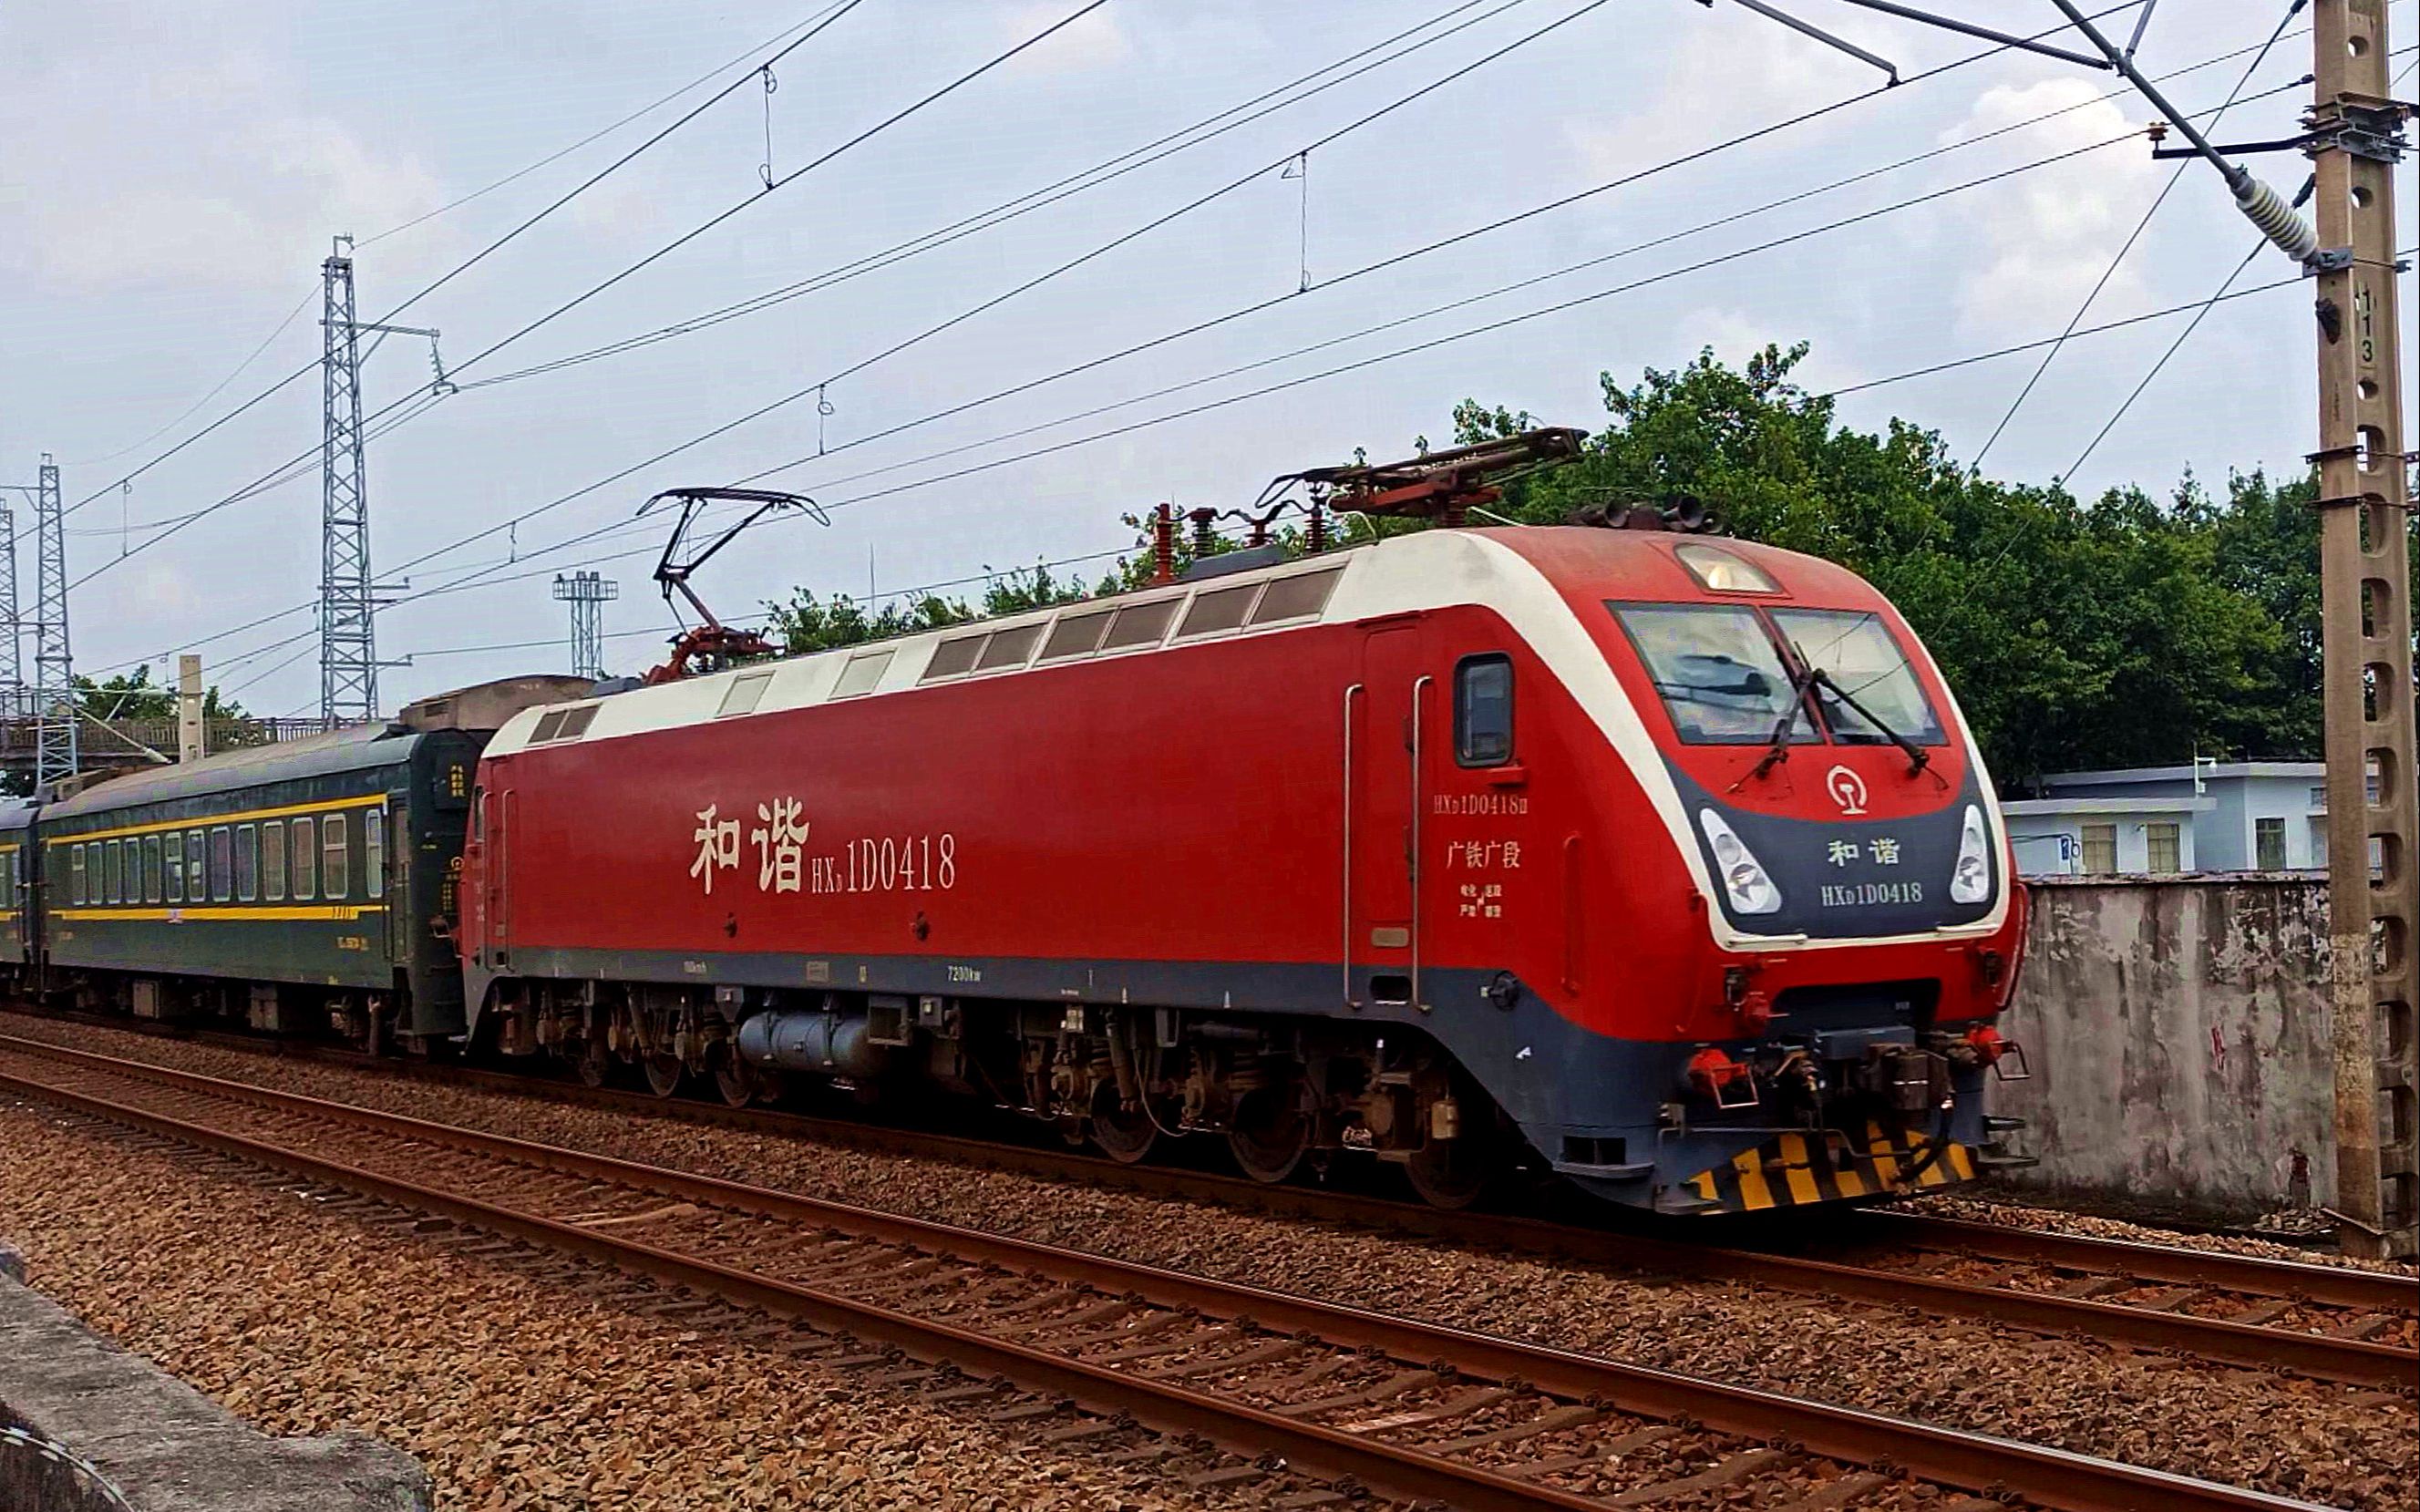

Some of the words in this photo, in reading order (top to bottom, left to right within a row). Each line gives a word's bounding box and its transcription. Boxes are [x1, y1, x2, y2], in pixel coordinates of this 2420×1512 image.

[690, 796, 810, 895] 和谐
[1446, 840, 1521, 869] 广铁广段
[1828, 838, 1900, 867] 和谐
[1821, 881, 1923, 907] HXD1D0418
